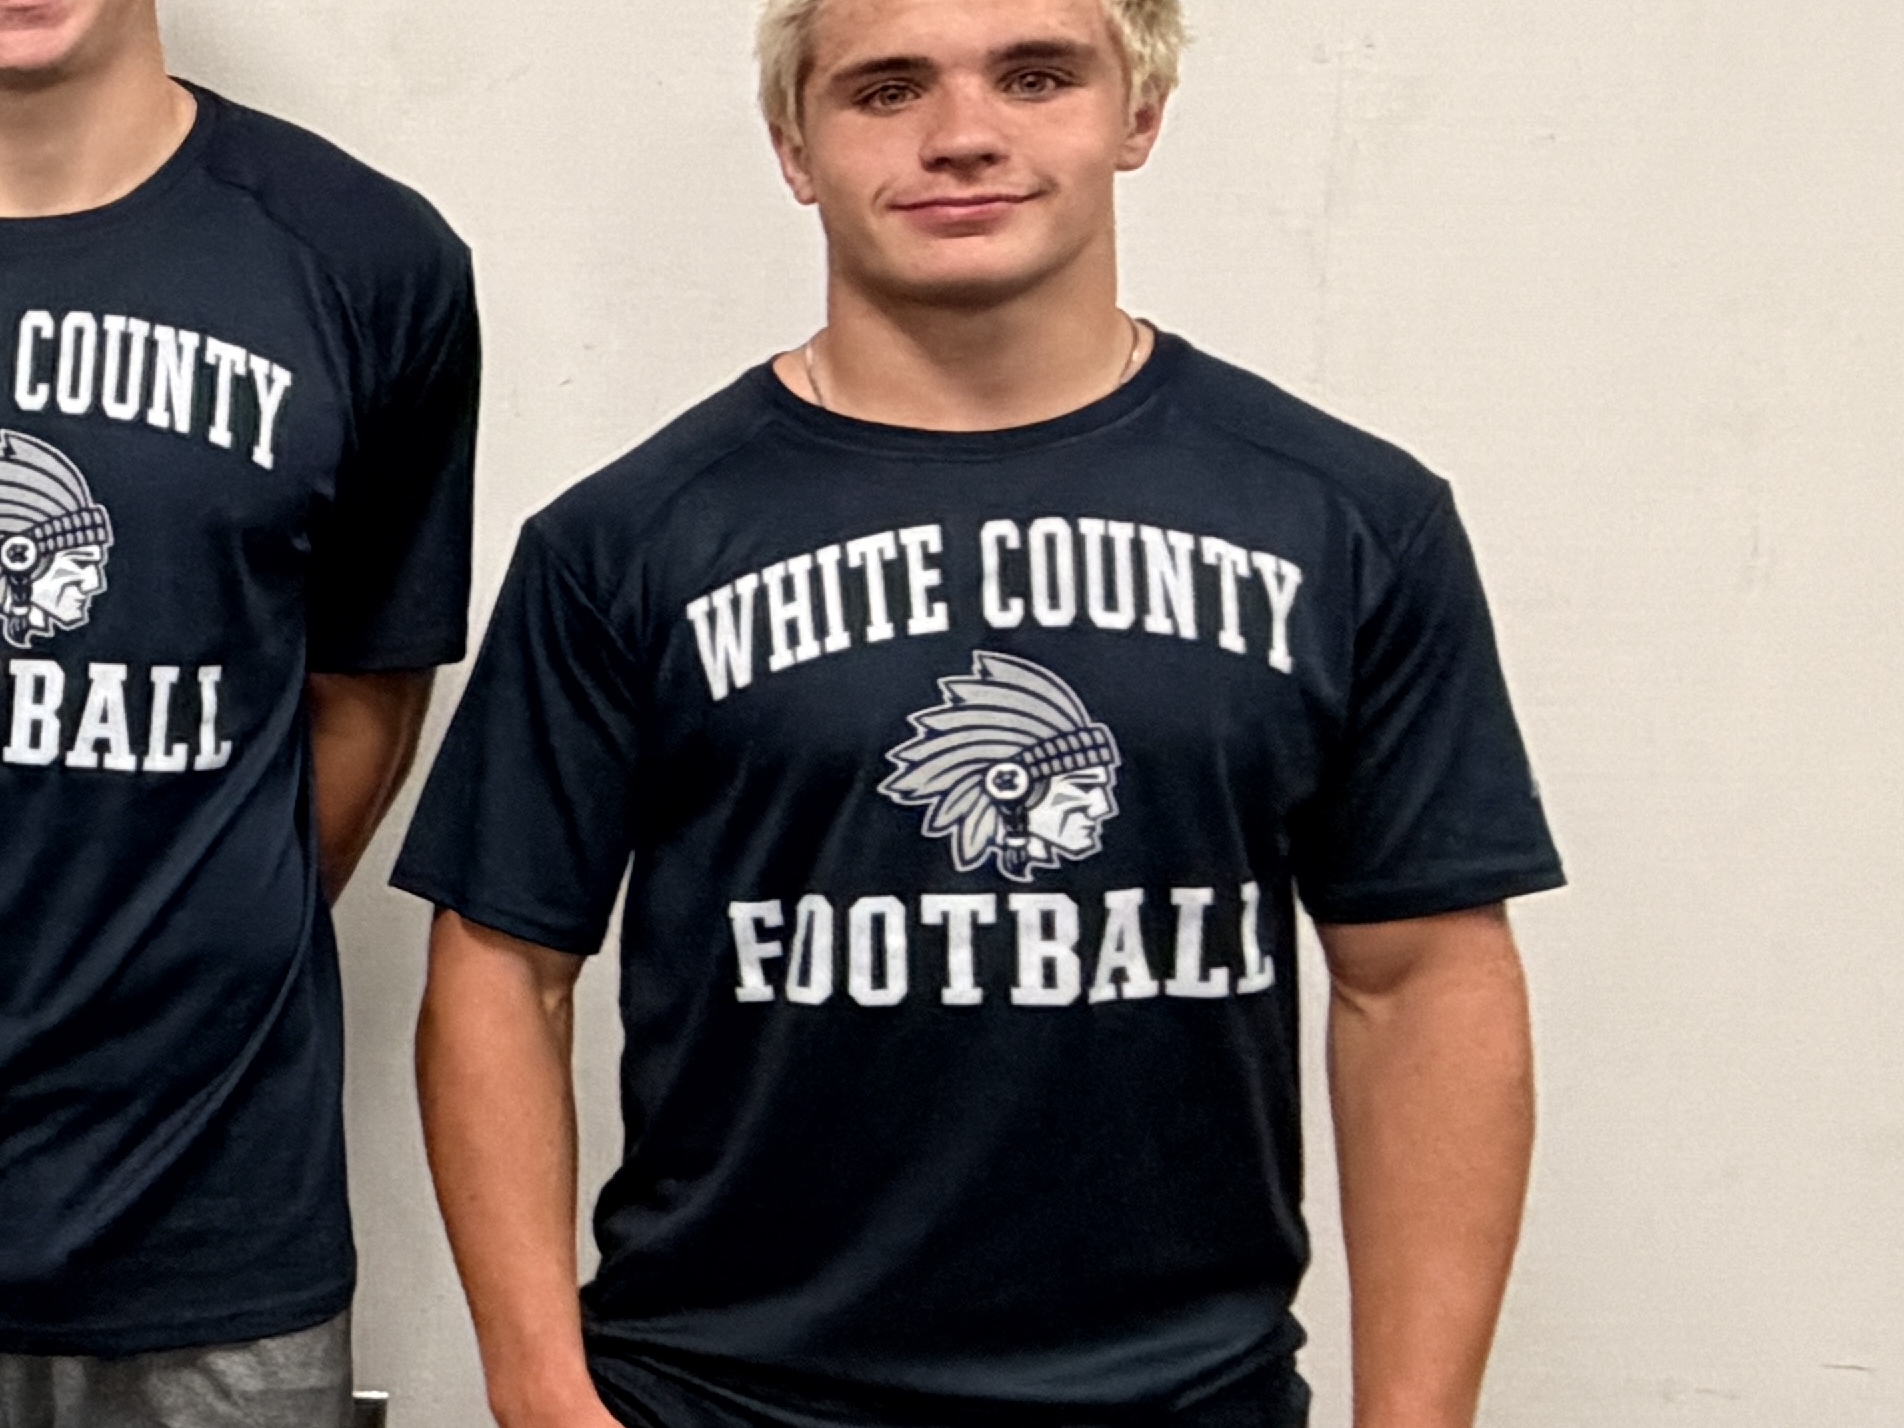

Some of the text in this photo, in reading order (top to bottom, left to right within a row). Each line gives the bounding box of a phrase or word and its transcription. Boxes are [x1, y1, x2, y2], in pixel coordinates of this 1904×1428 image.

[15, 310, 291, 469] COUNTY
[687, 517, 1302, 700] WHITE COUNTY
[728, 881, 1275, 1006] FOOTBALL
